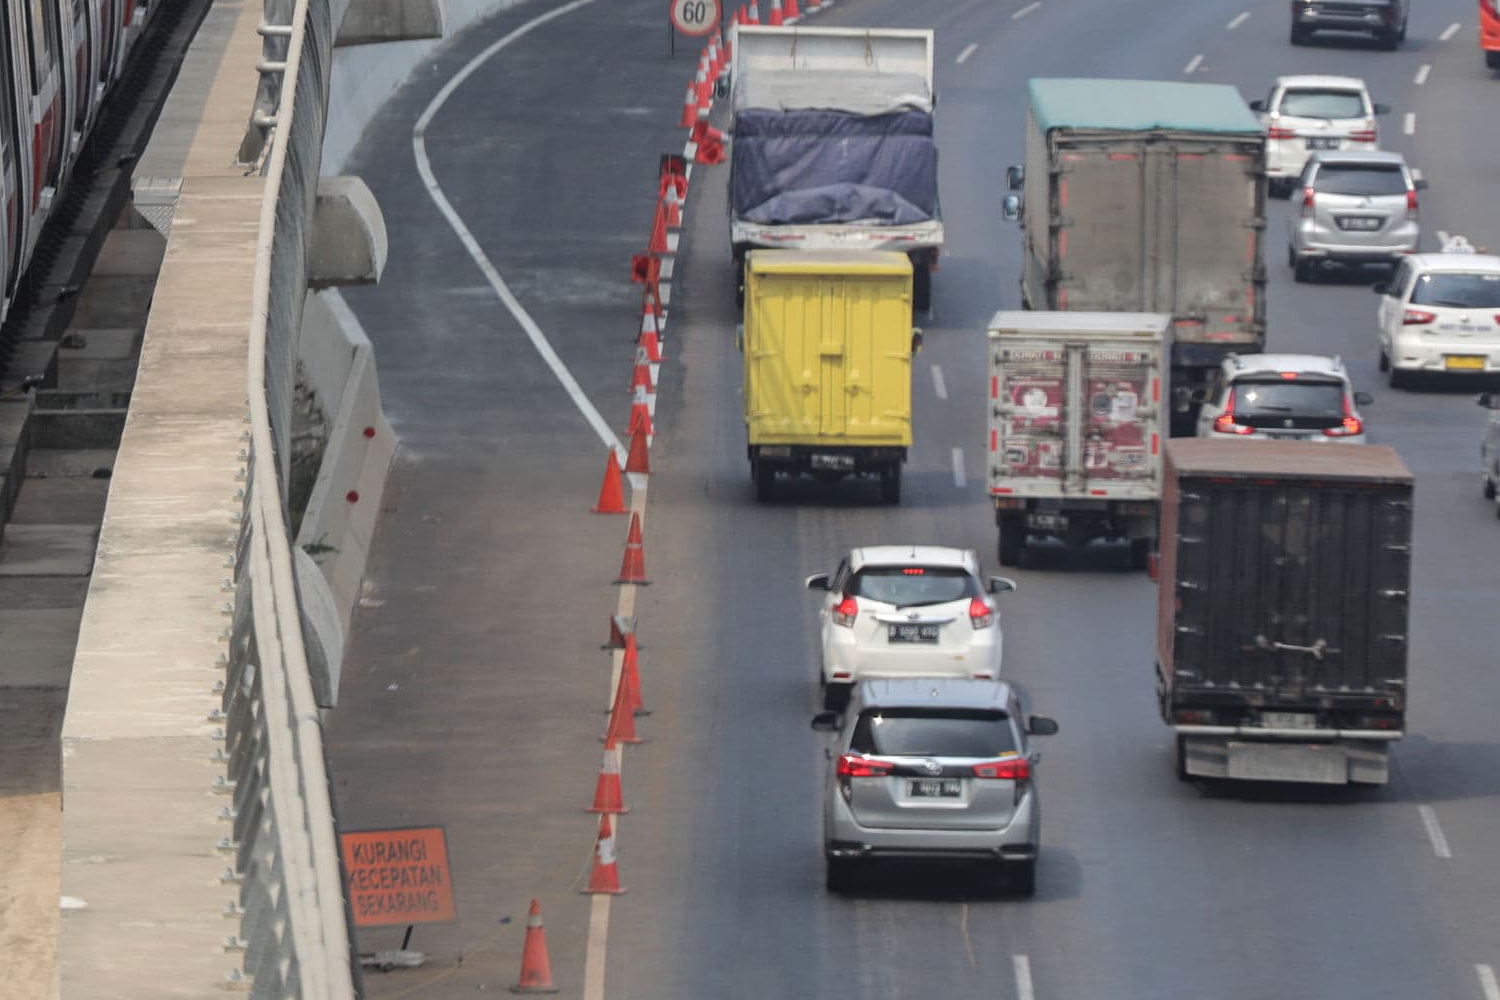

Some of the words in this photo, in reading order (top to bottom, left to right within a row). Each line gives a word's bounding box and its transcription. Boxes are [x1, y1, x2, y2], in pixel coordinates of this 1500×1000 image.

[683, 0, 706, 24] 60
[351, 839, 428, 864] KURANGI
[347, 865, 442, 891] KECEPATAN
[357, 890, 439, 916] SEKARANG
